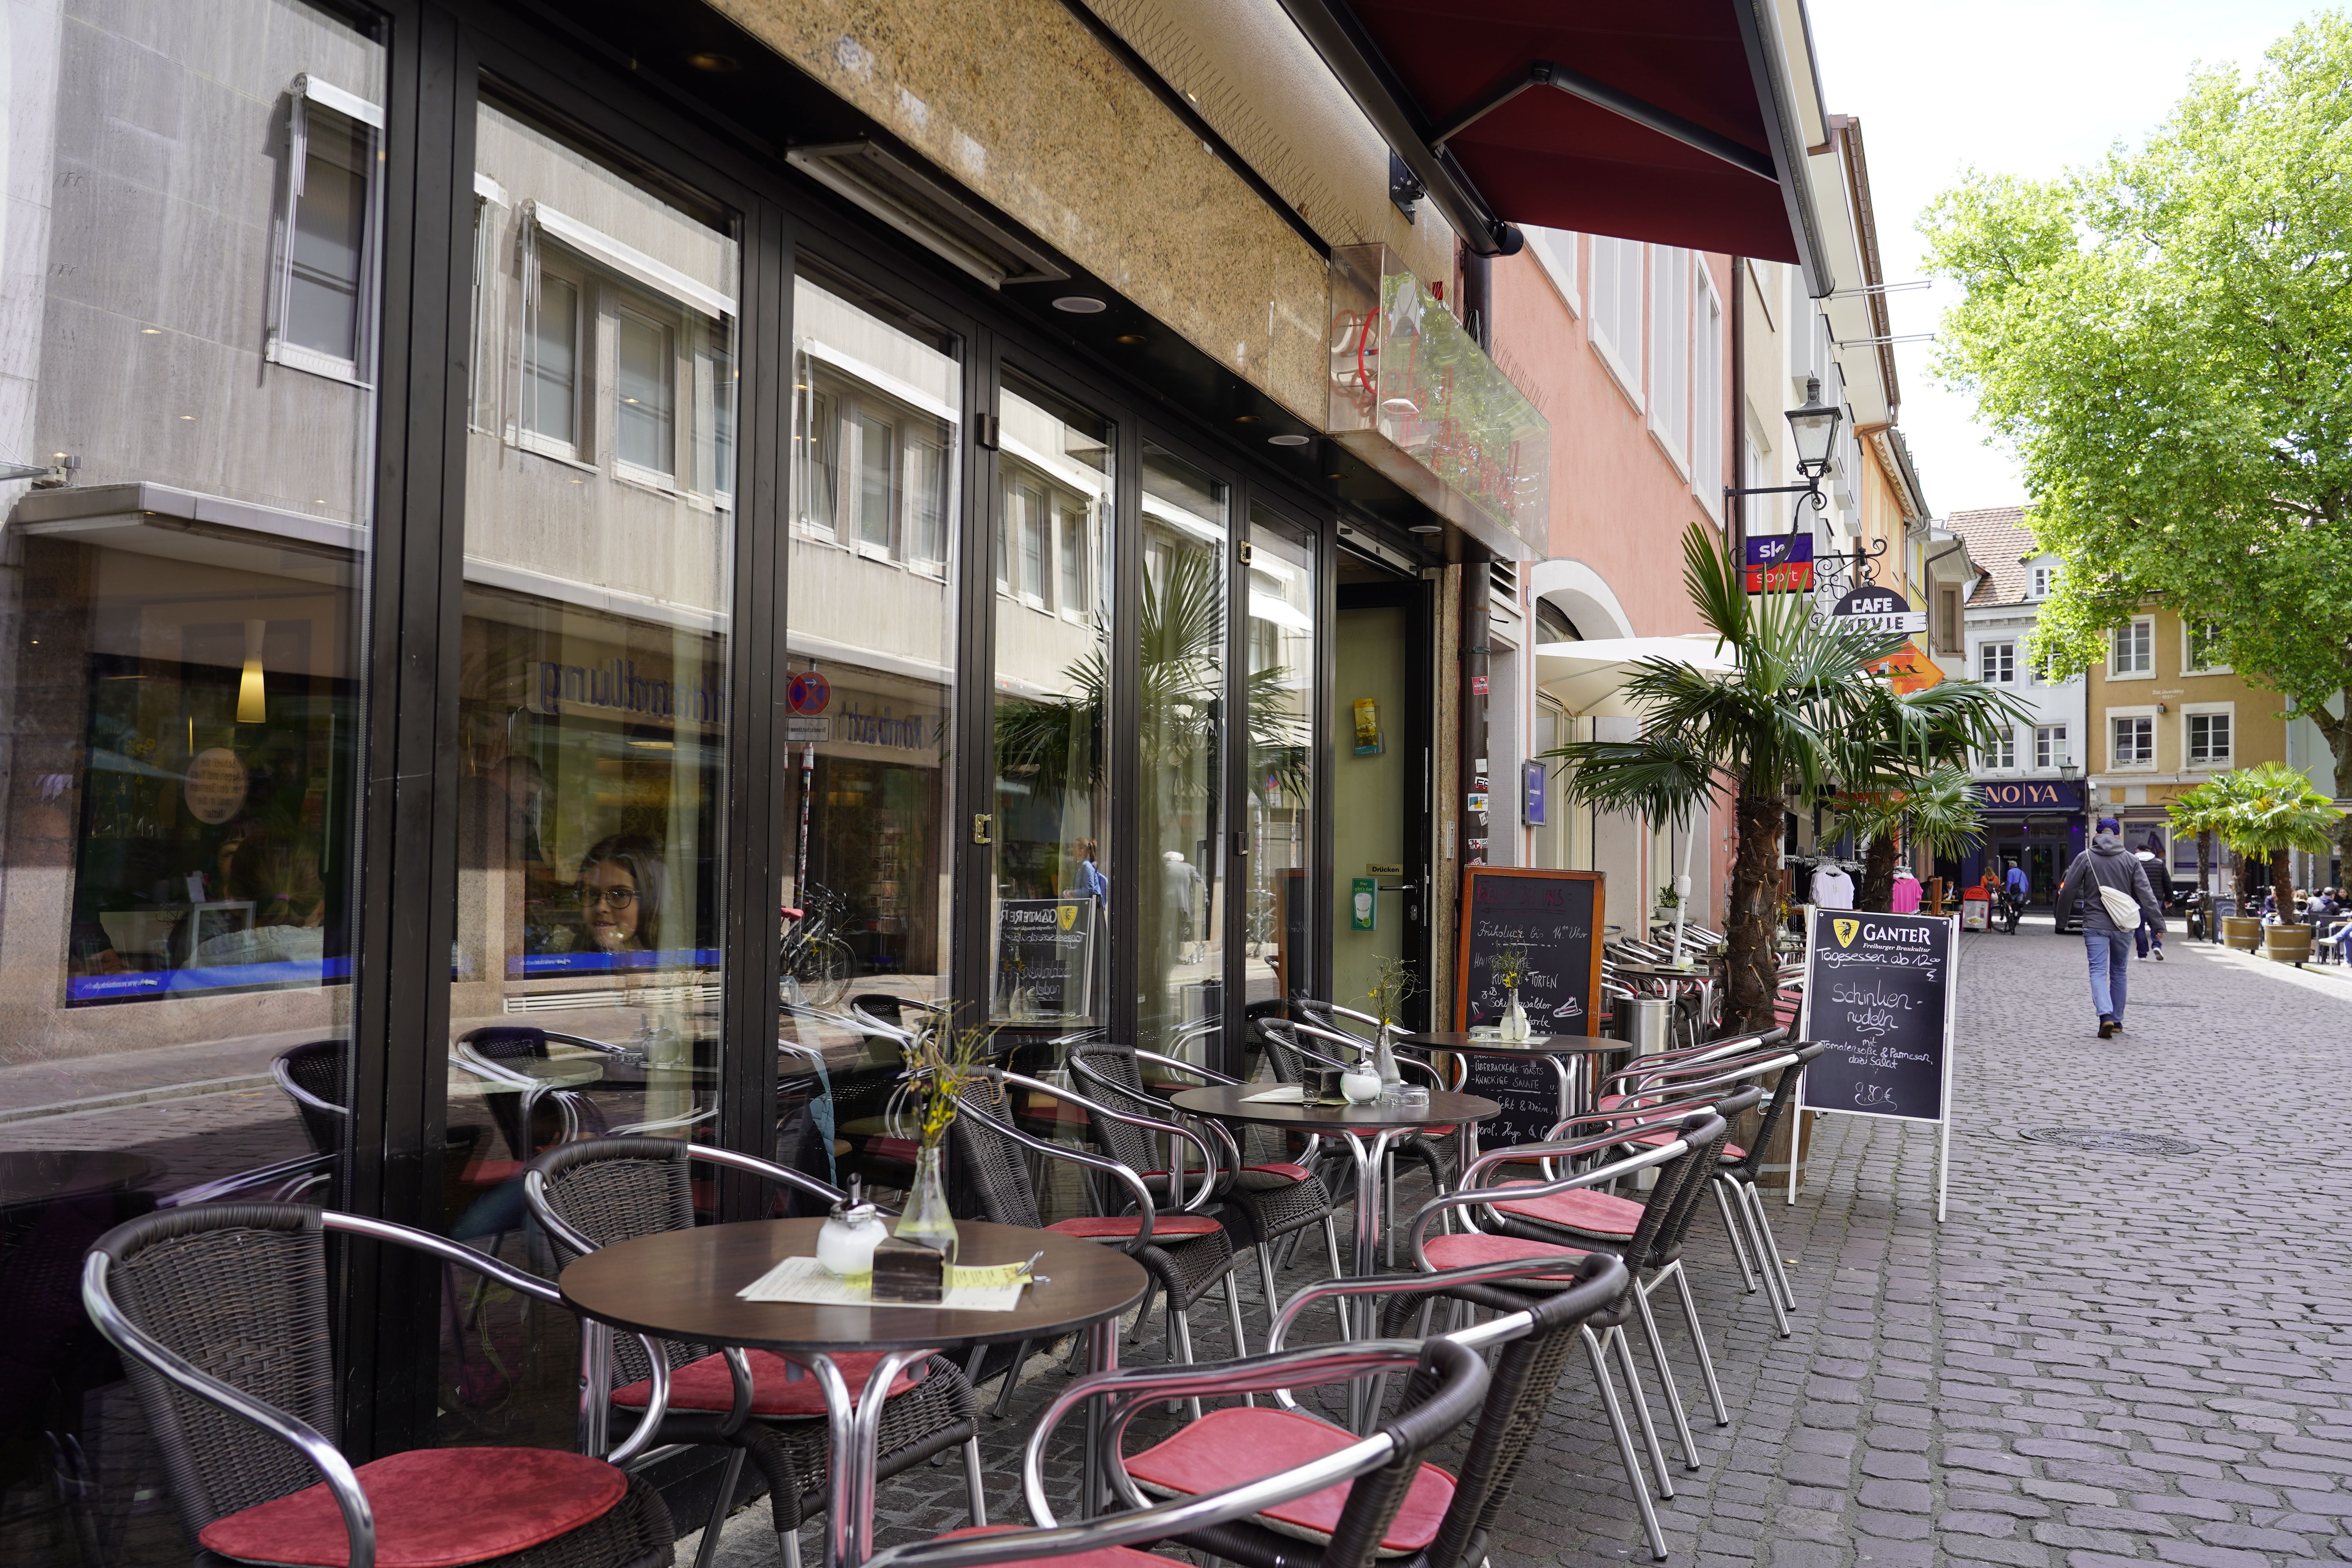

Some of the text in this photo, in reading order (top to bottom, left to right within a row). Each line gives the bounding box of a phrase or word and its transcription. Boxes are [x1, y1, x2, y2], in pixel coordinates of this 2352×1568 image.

[1756, 570, 1798, 583] spot
[1852, 597, 1893, 613] CAFE
[1477, 920, 1524, 938] Frühstück
[1530, 926, 1544, 939] bis
[1569, 926, 1588, 939] Uhr
[1863, 923, 1931, 945] GANTER
[1862, 943, 1895, 951] Freiburger
[1816, 947, 1887, 969] Tagesessen
[1890, 952, 1909, 966] ab
[1528, 971, 1559, 989] TORTEN
[1847, 1008, 1899, 1029] nudeln
[1862, 1036, 1877, 1047] mit
[1880, 1047, 1888, 1058] &
[1848, 1054, 1898, 1069] dazu Salat
[1520, 1064, 1544, 1076] TOASTS
[1512, 1077, 1539, 1089] SALATE
[1519, 1100, 1526, 1112] &
[1502, 1121, 1521, 1145] Hugo
